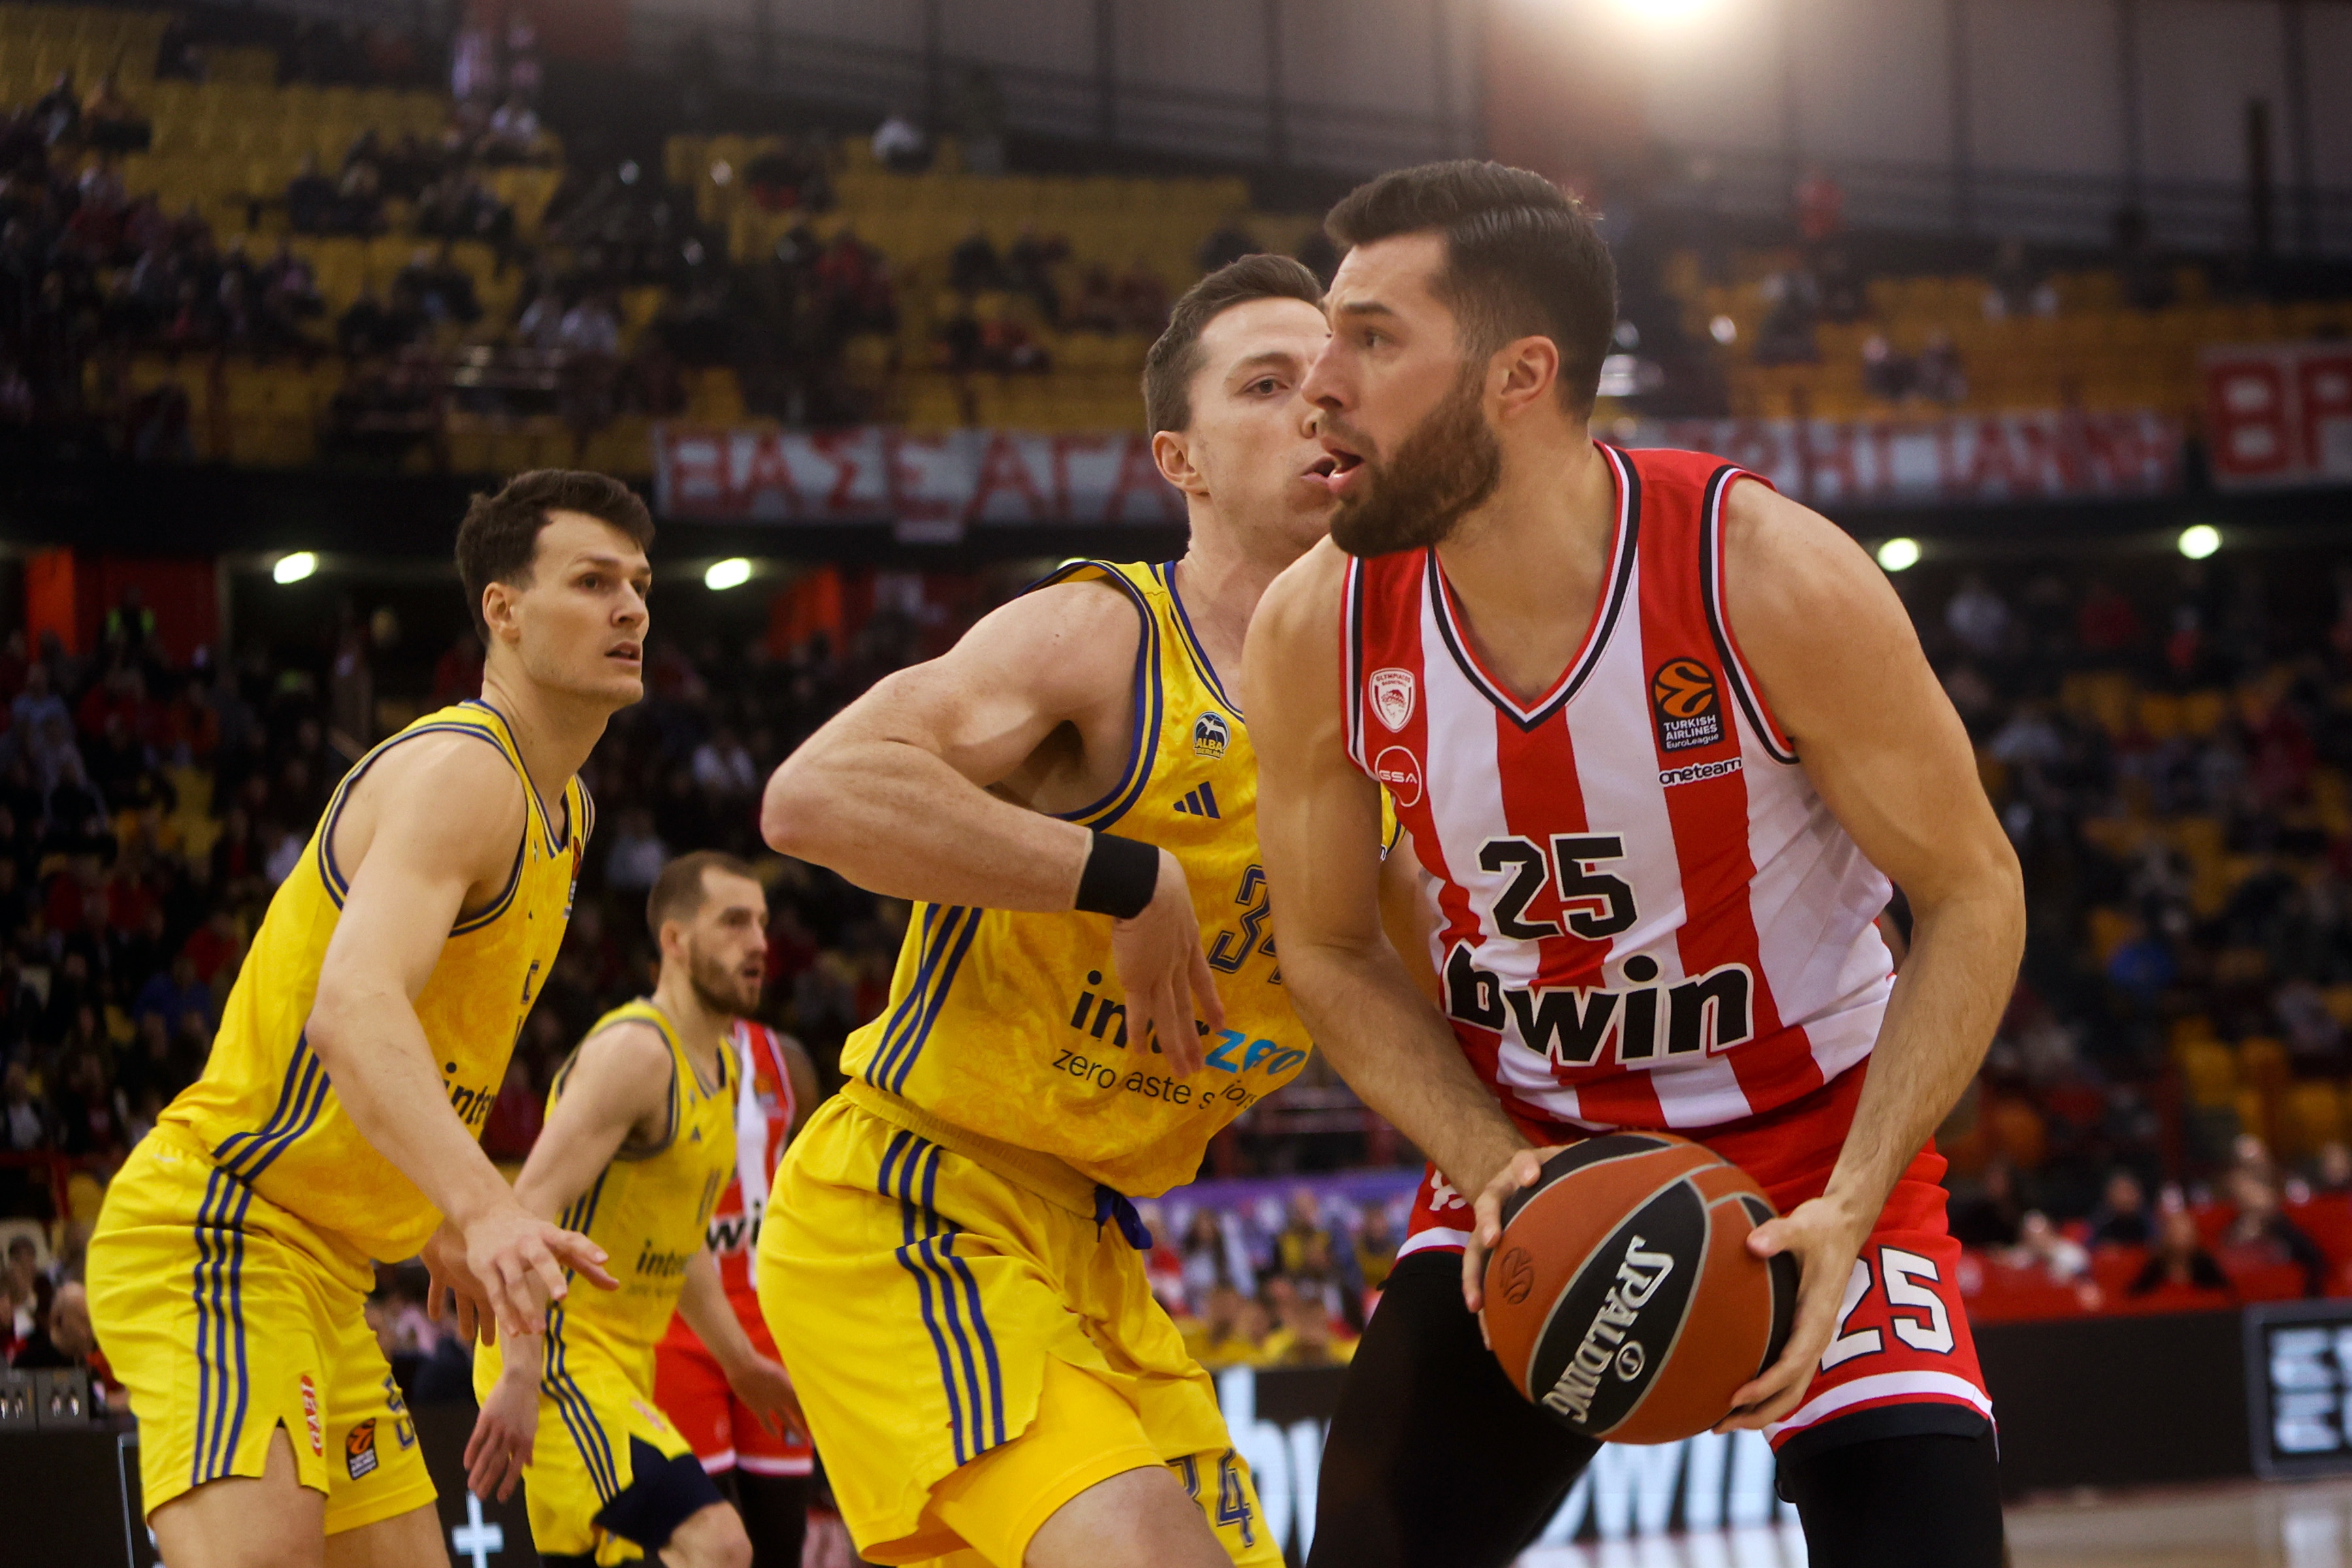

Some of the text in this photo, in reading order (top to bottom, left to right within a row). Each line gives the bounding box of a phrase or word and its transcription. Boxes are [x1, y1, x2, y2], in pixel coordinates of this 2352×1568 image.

[1663, 714, 1716, 731] TURKISH
[1665, 723, 1718, 741] AIRLINES
[1195, 737, 1224, 753] ALBA
[1666, 733, 1720, 749] EuroLeague
[1379, 770, 1418, 784] GSA
[1658, 757, 1743, 786] oneteam
[1475, 832, 1638, 941] 25
[1442, 939, 1754, 1068] bwin
[1052, 1048, 1116, 1089] zero
[1126, 1071, 1191, 1105] aste
[1820, 1245, 1955, 1373] 25
[1541, 1233, 1675, 1424] SPALDING
